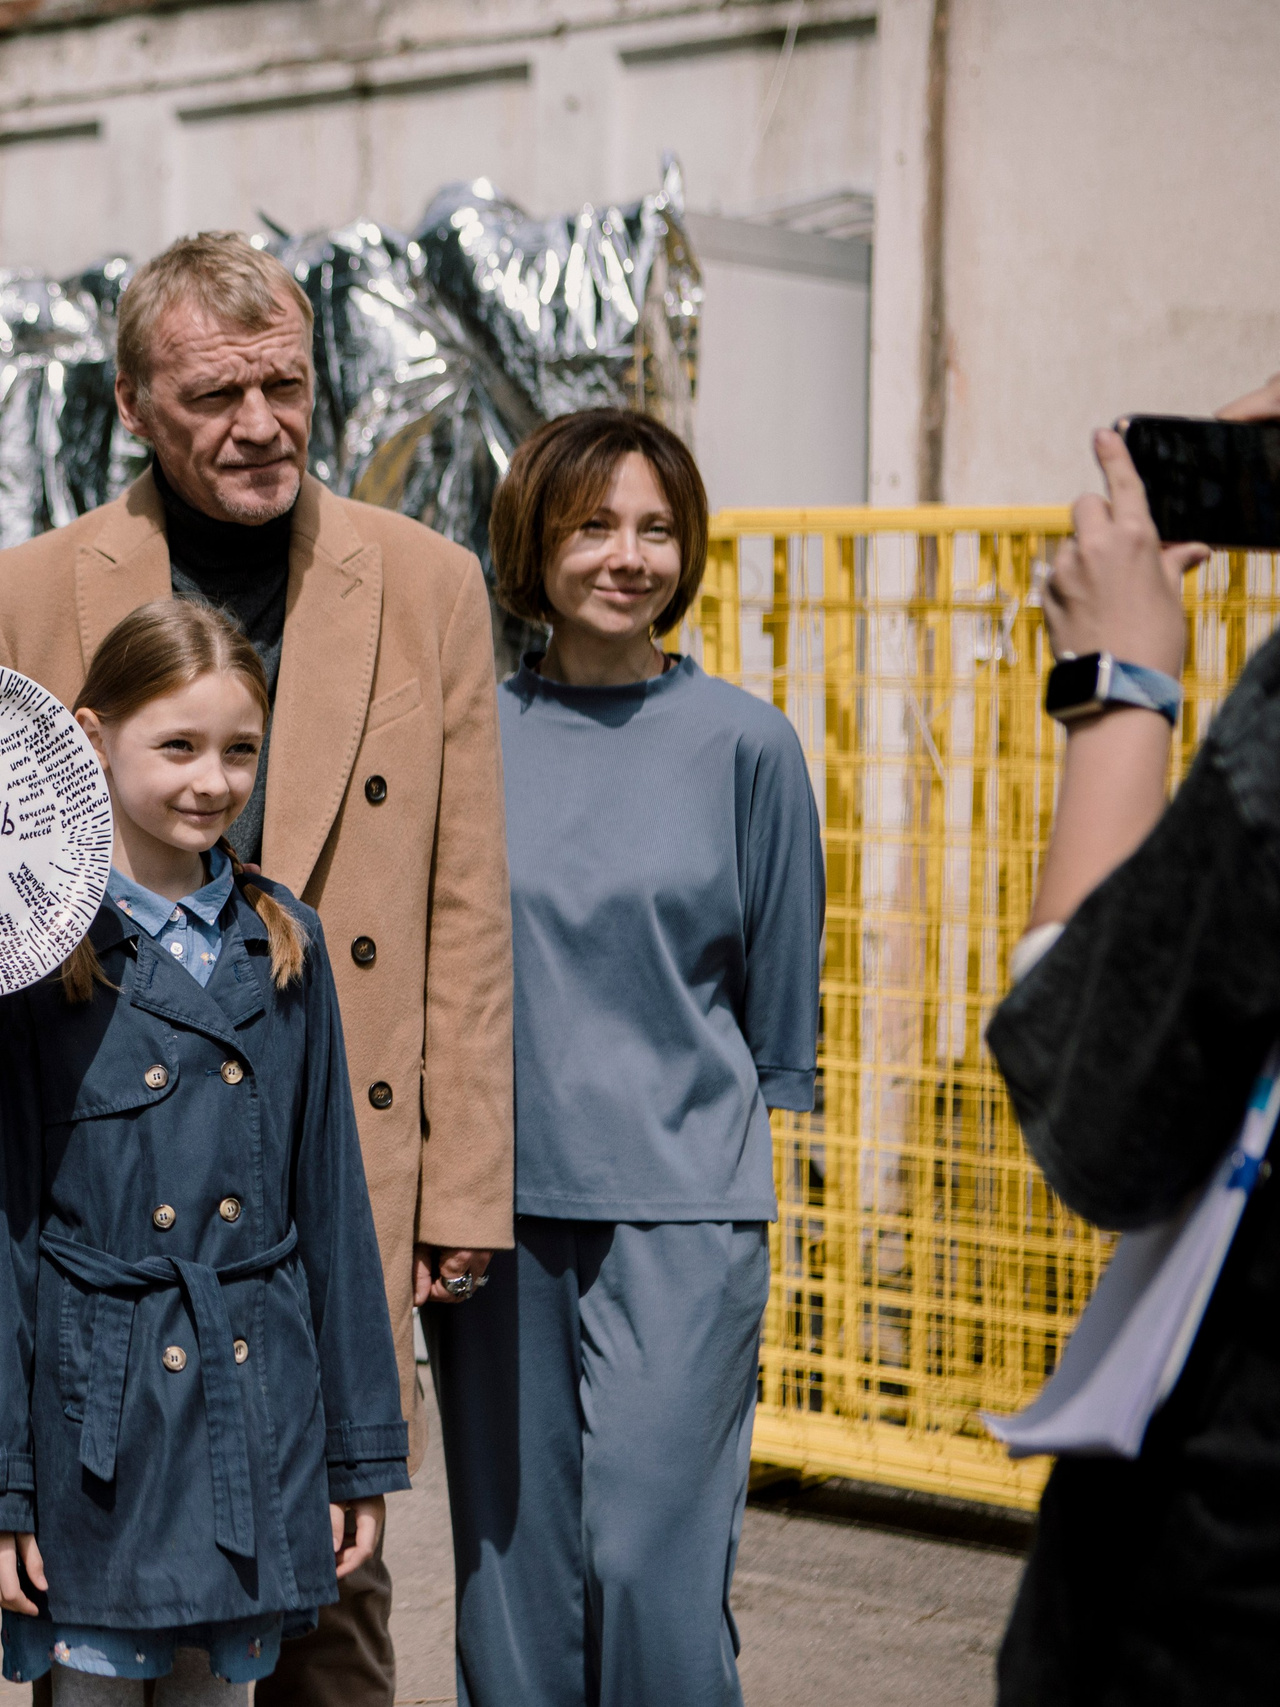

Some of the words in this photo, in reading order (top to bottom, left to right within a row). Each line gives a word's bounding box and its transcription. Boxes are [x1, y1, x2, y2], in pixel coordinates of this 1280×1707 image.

[7, 770, 38, 791] АЛЕКСЕЙ
[45, 745, 84, 773] ШИШКИН
[19, 789, 45, 805] МАРИЯ
[19, 803, 56, 822] ВЯЧЕСЛАВ
[19, 825, 52, 841] АЛЕКСЕЙ
[61, 793, 109, 829] БЕРНАЦКИЙ
[34, 815, 56, 827] АННА
[16, 872, 48, 916] БАРАНОВА
[21, 951, 41, 978] АЛИСА
